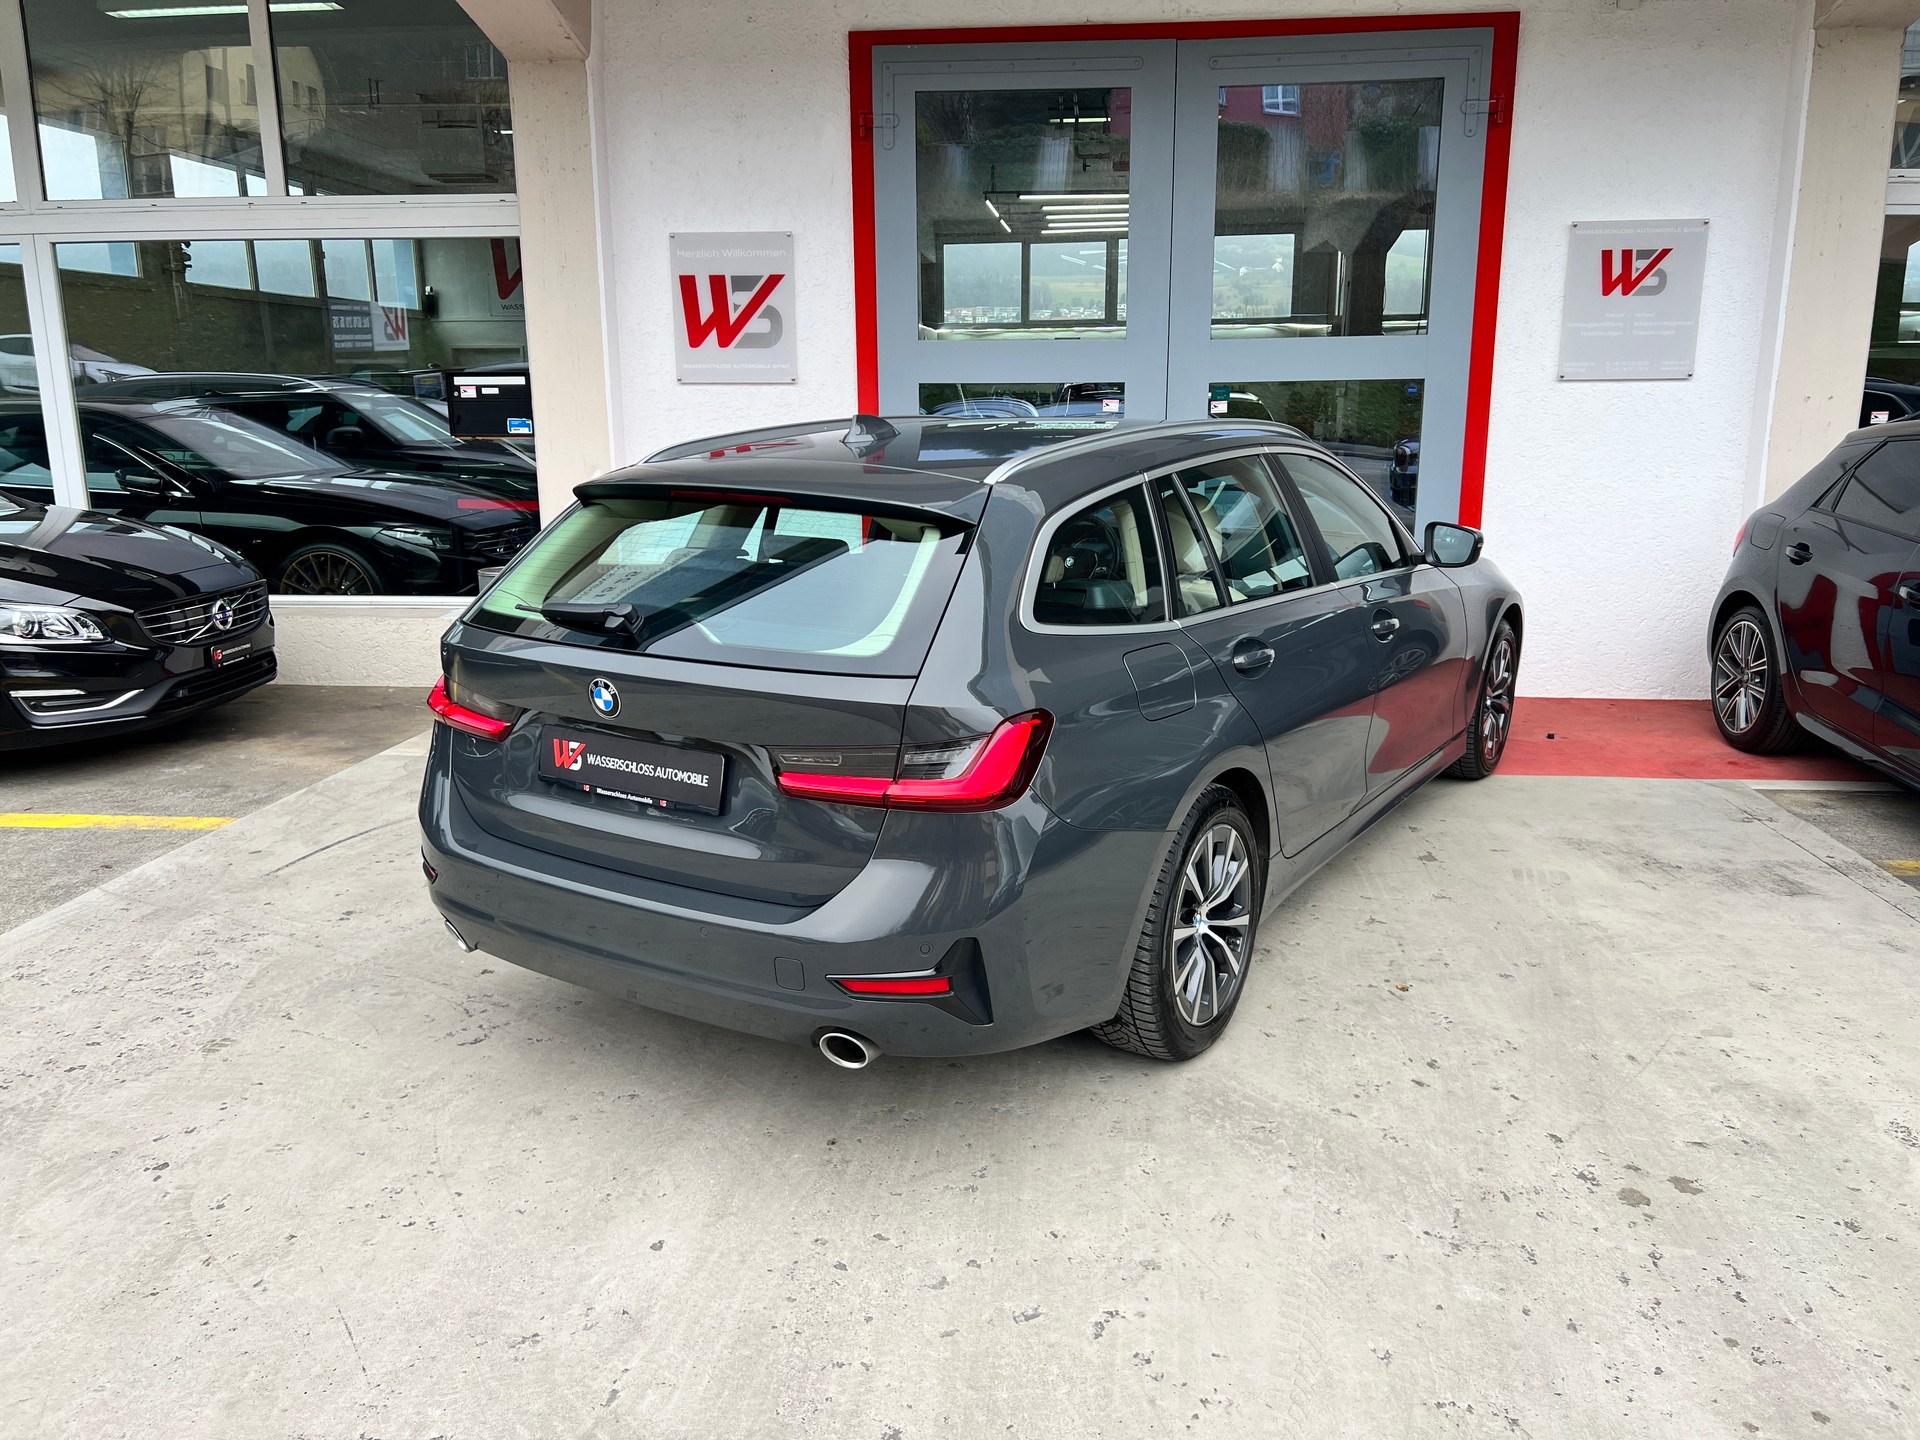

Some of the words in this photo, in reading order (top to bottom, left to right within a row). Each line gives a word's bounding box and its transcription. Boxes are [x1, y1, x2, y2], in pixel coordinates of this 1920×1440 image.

[676, 248, 720, 258] Herzlich
[722, 248, 786, 257] Willkommen
[590, 680, 616, 695] BMW
[586, 753, 655, 777] WASSERSCHLOSS
[655, 766, 710, 787] AUTOMOBILE
[596, 787, 627, 799] Wasserschloss
[627, 793, 653, 804] Automobile
